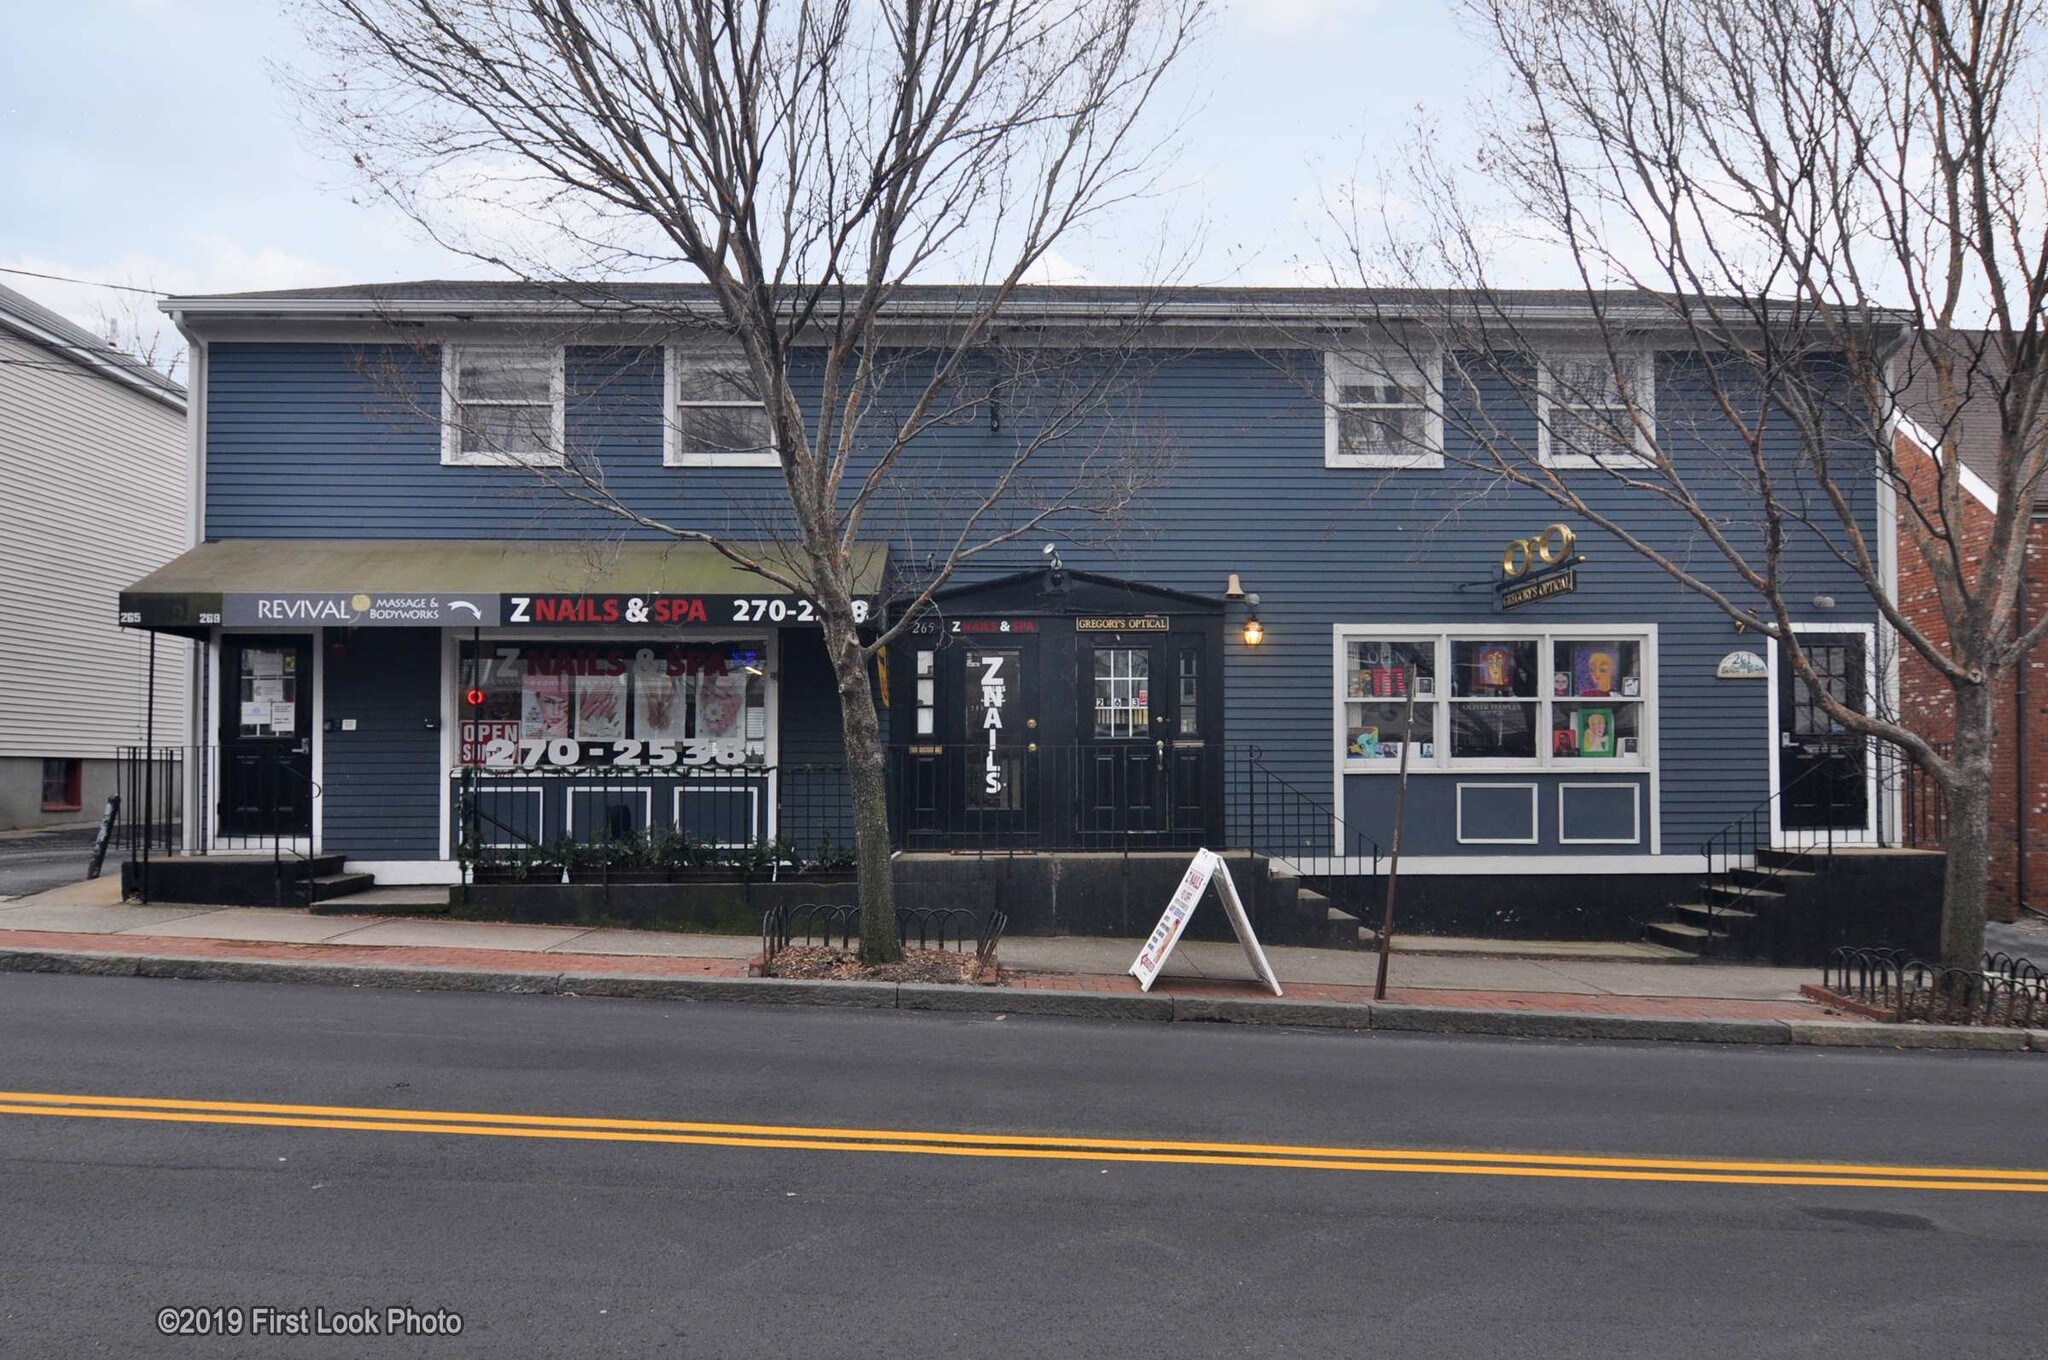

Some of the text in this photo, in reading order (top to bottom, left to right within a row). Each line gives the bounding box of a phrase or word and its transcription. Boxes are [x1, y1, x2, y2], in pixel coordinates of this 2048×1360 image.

[1539, 575, 1569, 596] OPTICAL
[376, 597, 439, 608] MASSAGE &
[258, 600, 350, 619] REVIVAL
[370, 609, 439, 620] BODYWORKS
[510, 597, 869, 623] Z NAILS & SPA 270-28
[120, 611, 141, 623] 265
[199, 612, 220, 624] 269
[912, 621, 935, 634] 265
[952, 621, 961, 632] Z
[1000, 620, 1010, 632] &
[1079, 619, 1166, 629] GREGORY'S OPTICAL
[496, 648, 519, 677] Z
[526, 650, 626, 677] NAILS
[633, 648, 658, 677] &
[665, 650, 729, 677] SPA
[981, 656, 1004, 686] Z
[462, 724, 518, 743] OPEN
